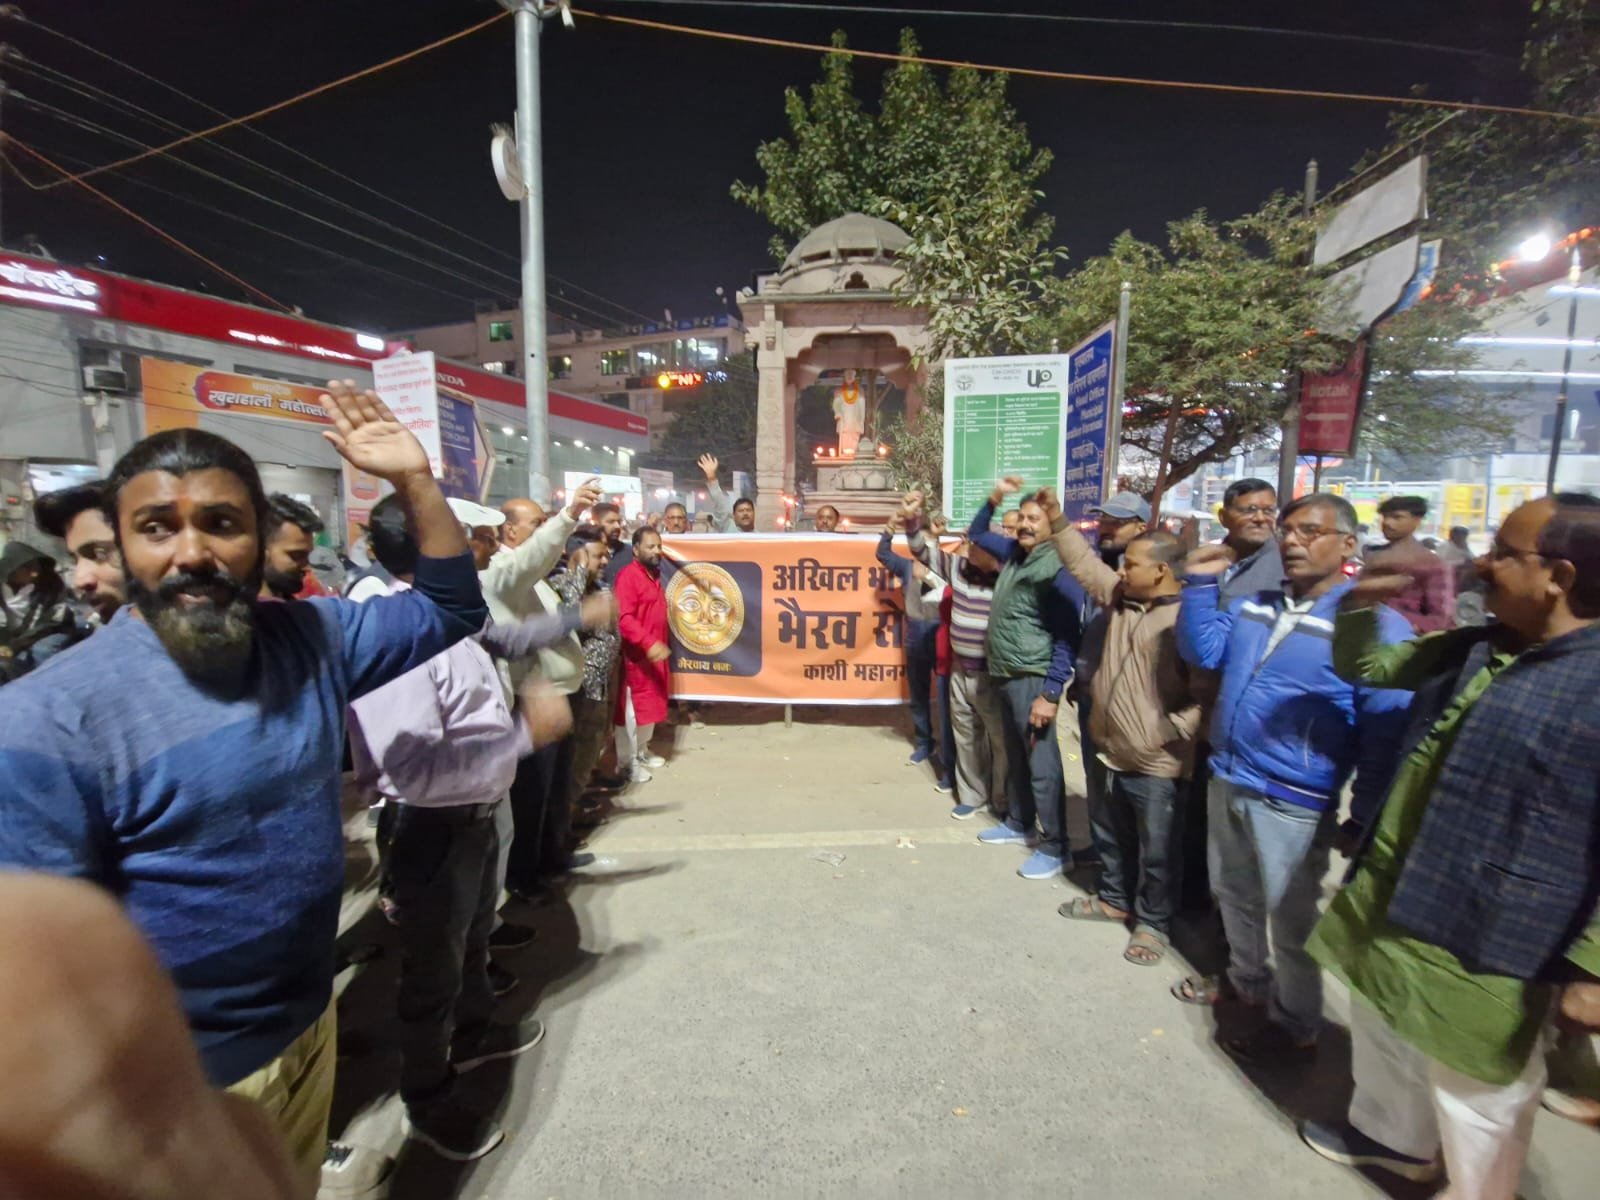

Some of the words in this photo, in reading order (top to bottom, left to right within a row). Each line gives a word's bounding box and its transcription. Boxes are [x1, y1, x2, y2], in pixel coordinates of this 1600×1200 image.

[436, 373, 466, 387] NDA
[772, 557, 862, 592] अखिल
[774, 596, 862, 650] भैरव
[803, 659, 847, 680] काशी
